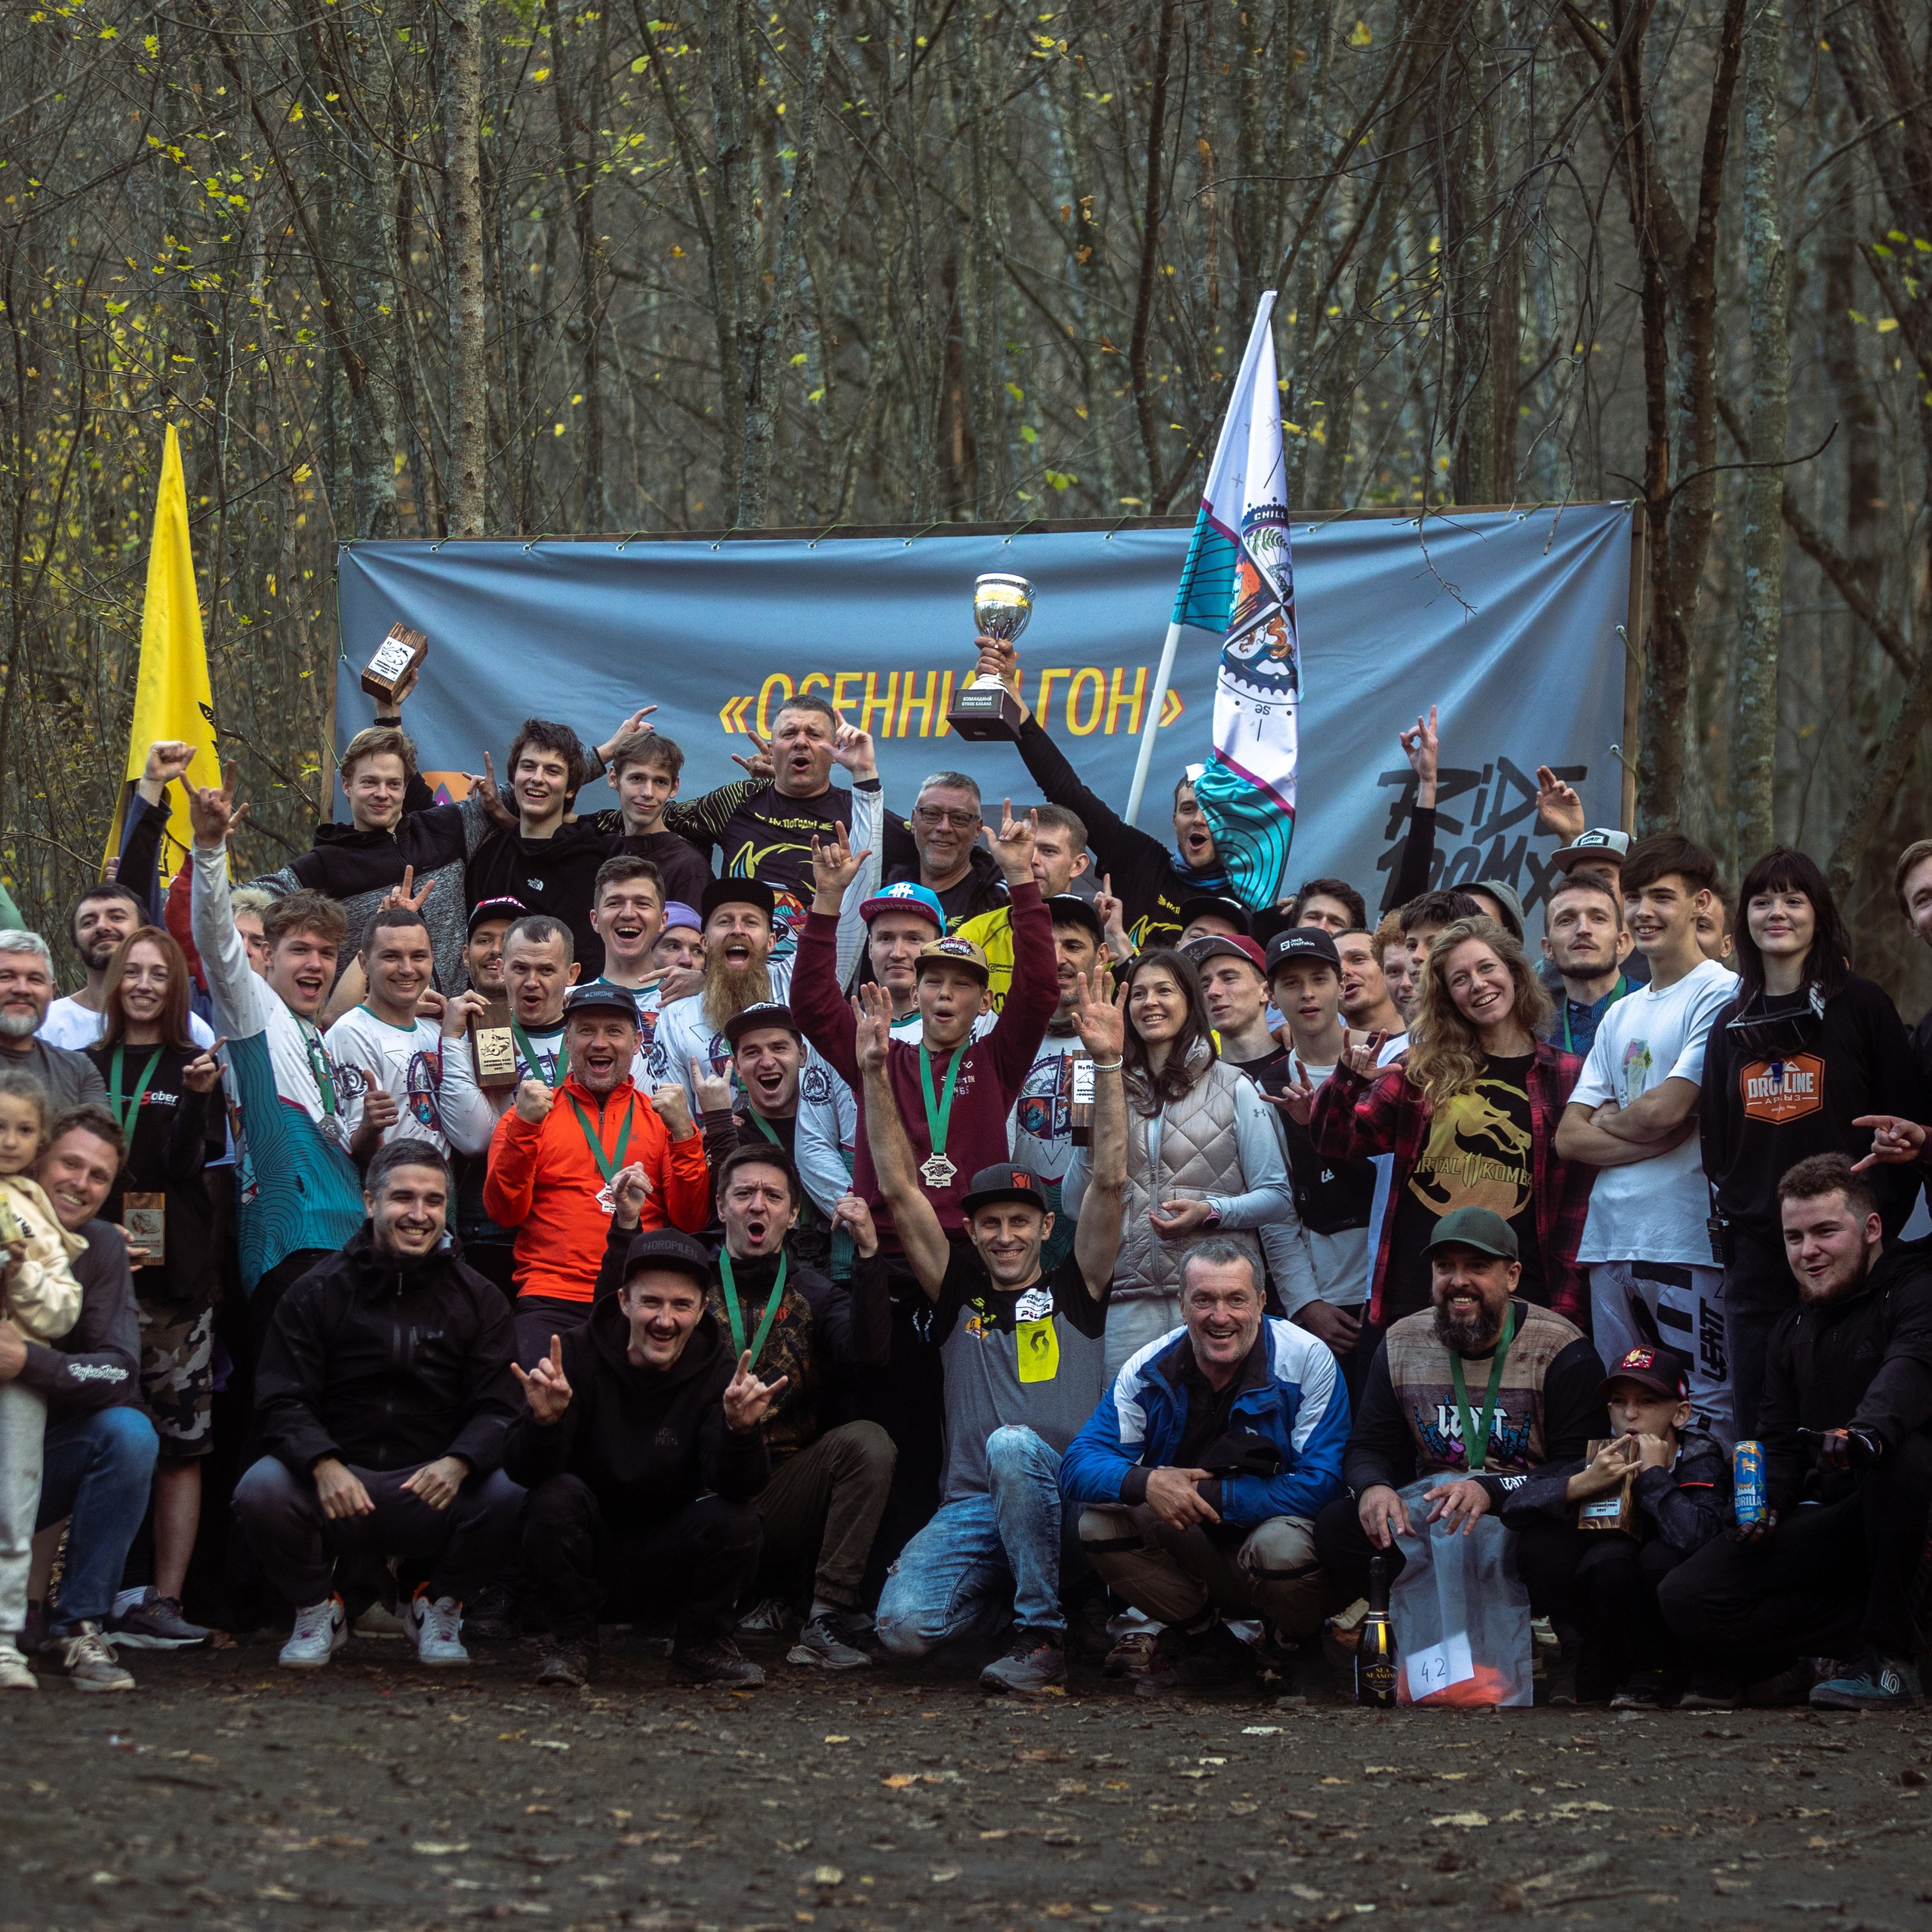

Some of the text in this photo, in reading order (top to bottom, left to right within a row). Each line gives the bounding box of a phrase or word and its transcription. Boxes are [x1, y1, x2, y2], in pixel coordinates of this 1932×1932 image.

[1254, 511, 1286, 521] CHILL
[718, 655, 1024, 740] «ОЕННИ
[940, 943, 971, 955] RAMPAGE
[140, 1090, 179, 1106] Sober
[1764, 1094, 1801, 1105] АРЫЗ
[1414, 1156, 1461, 1174] RTAL
[1481, 1162, 1534, 1188] KOMBA
[1020, 1304, 1051, 1319] POLR
[1436, 1404, 1508, 1441] LET
[1734, 1495, 1762, 1508] GORILLA
[1421, 1657, 1446, 1683] 4.2
